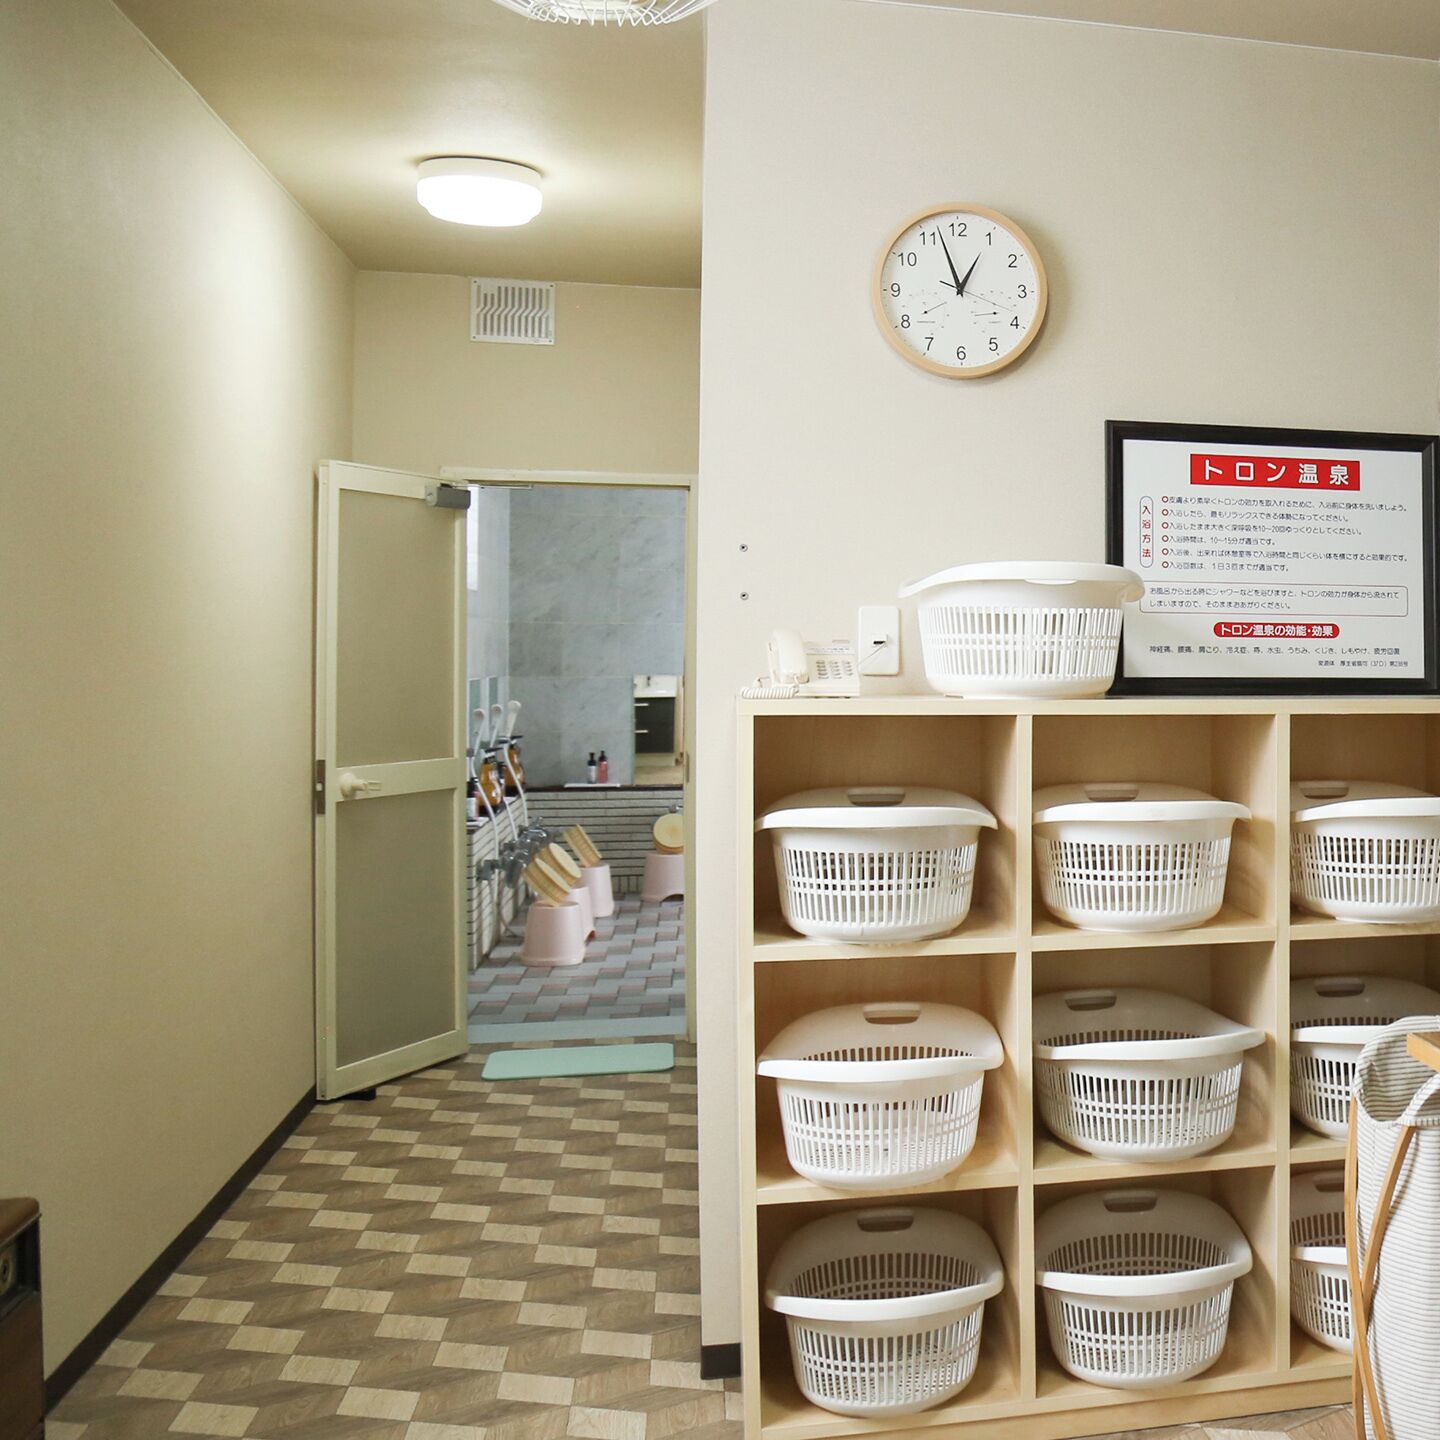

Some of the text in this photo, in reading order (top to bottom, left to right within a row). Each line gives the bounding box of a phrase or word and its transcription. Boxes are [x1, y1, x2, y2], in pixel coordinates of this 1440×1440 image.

[949, 223, 967, 236] 12
[920, 232, 935, 245] 11
[986, 233, 991, 245] 1
[898, 252, 916, 266] 10
[1008, 254, 1017, 268] 2
[891, 283, 900, 297] 9
[1018, 285, 1027, 298] 3
[901, 315, 910, 328] 8
[1010, 316, 1019, 329] 4
[925, 337, 933, 350] 7
[989, 338, 998, 351] 5
[957, 346, 966, 360] 6
[1204, 459, 1350, 485] トロン温泉
[1142, 505, 1151, 558] 入浴方法
[1219, 624, 1334, 638] トロン温泉の効能・効果
